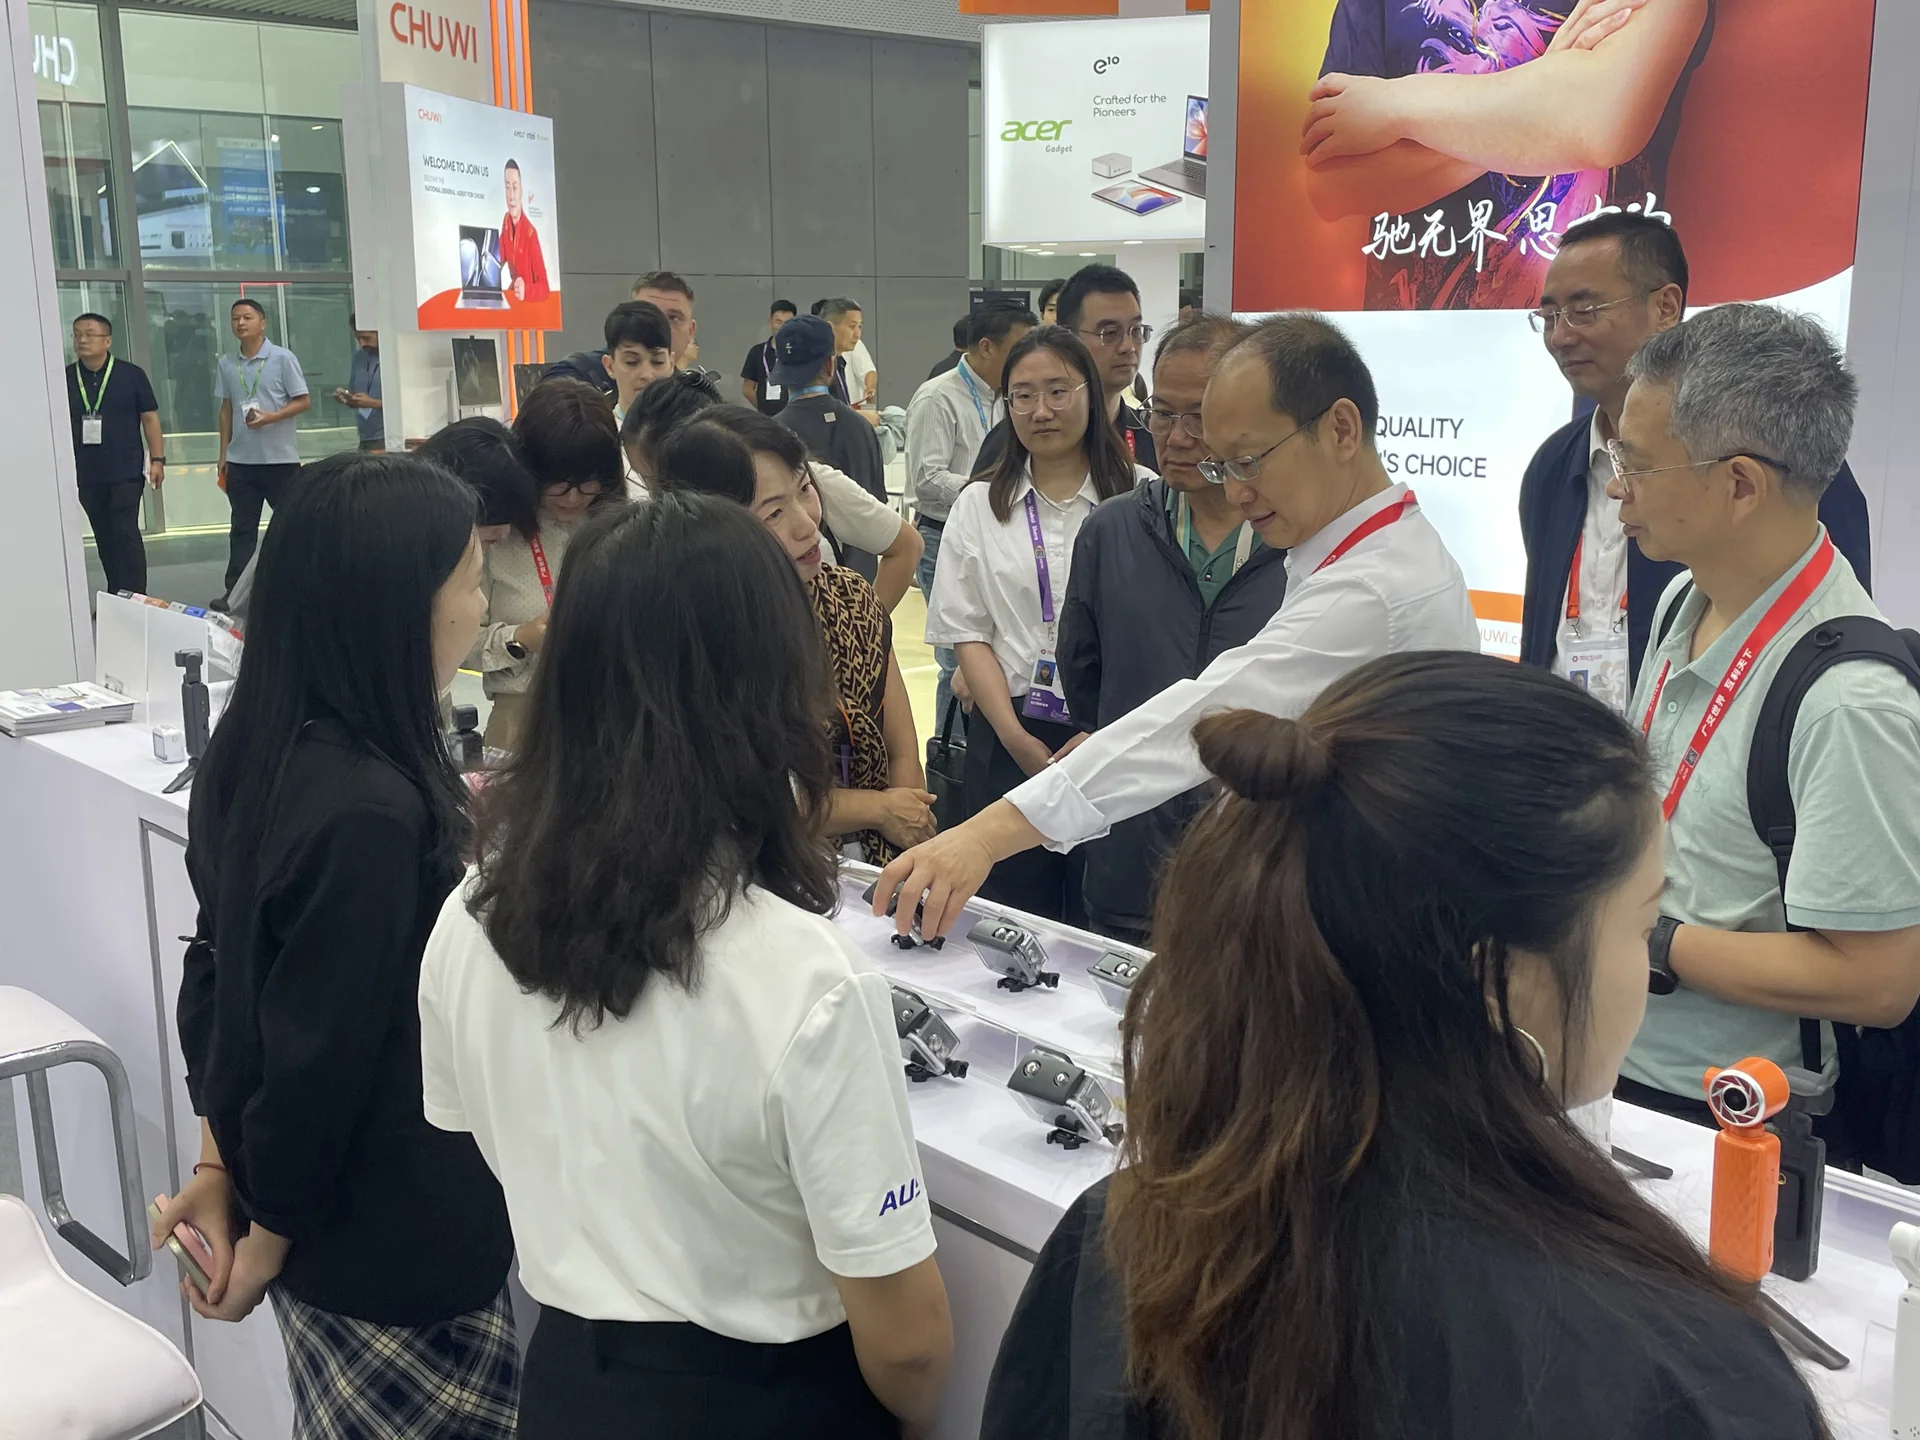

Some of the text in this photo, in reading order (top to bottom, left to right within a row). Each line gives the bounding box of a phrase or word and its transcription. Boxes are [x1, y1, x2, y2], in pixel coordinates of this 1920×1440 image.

[389, 2, 477, 64] CHUWI
[1093, 93, 1167, 105] Crafted for the
[418, 108, 442, 124] CHUWI
[1093, 107, 1136, 117] Pioneers
[1000, 119, 1073, 141] acer
[1045, 145, 1073, 154] Gadget
[422, 154, 489, 177] WELCOME TO JOIN US
[1376, 415, 1464, 440] QUALITY
[1405, 453, 1487, 479] CHOICE
